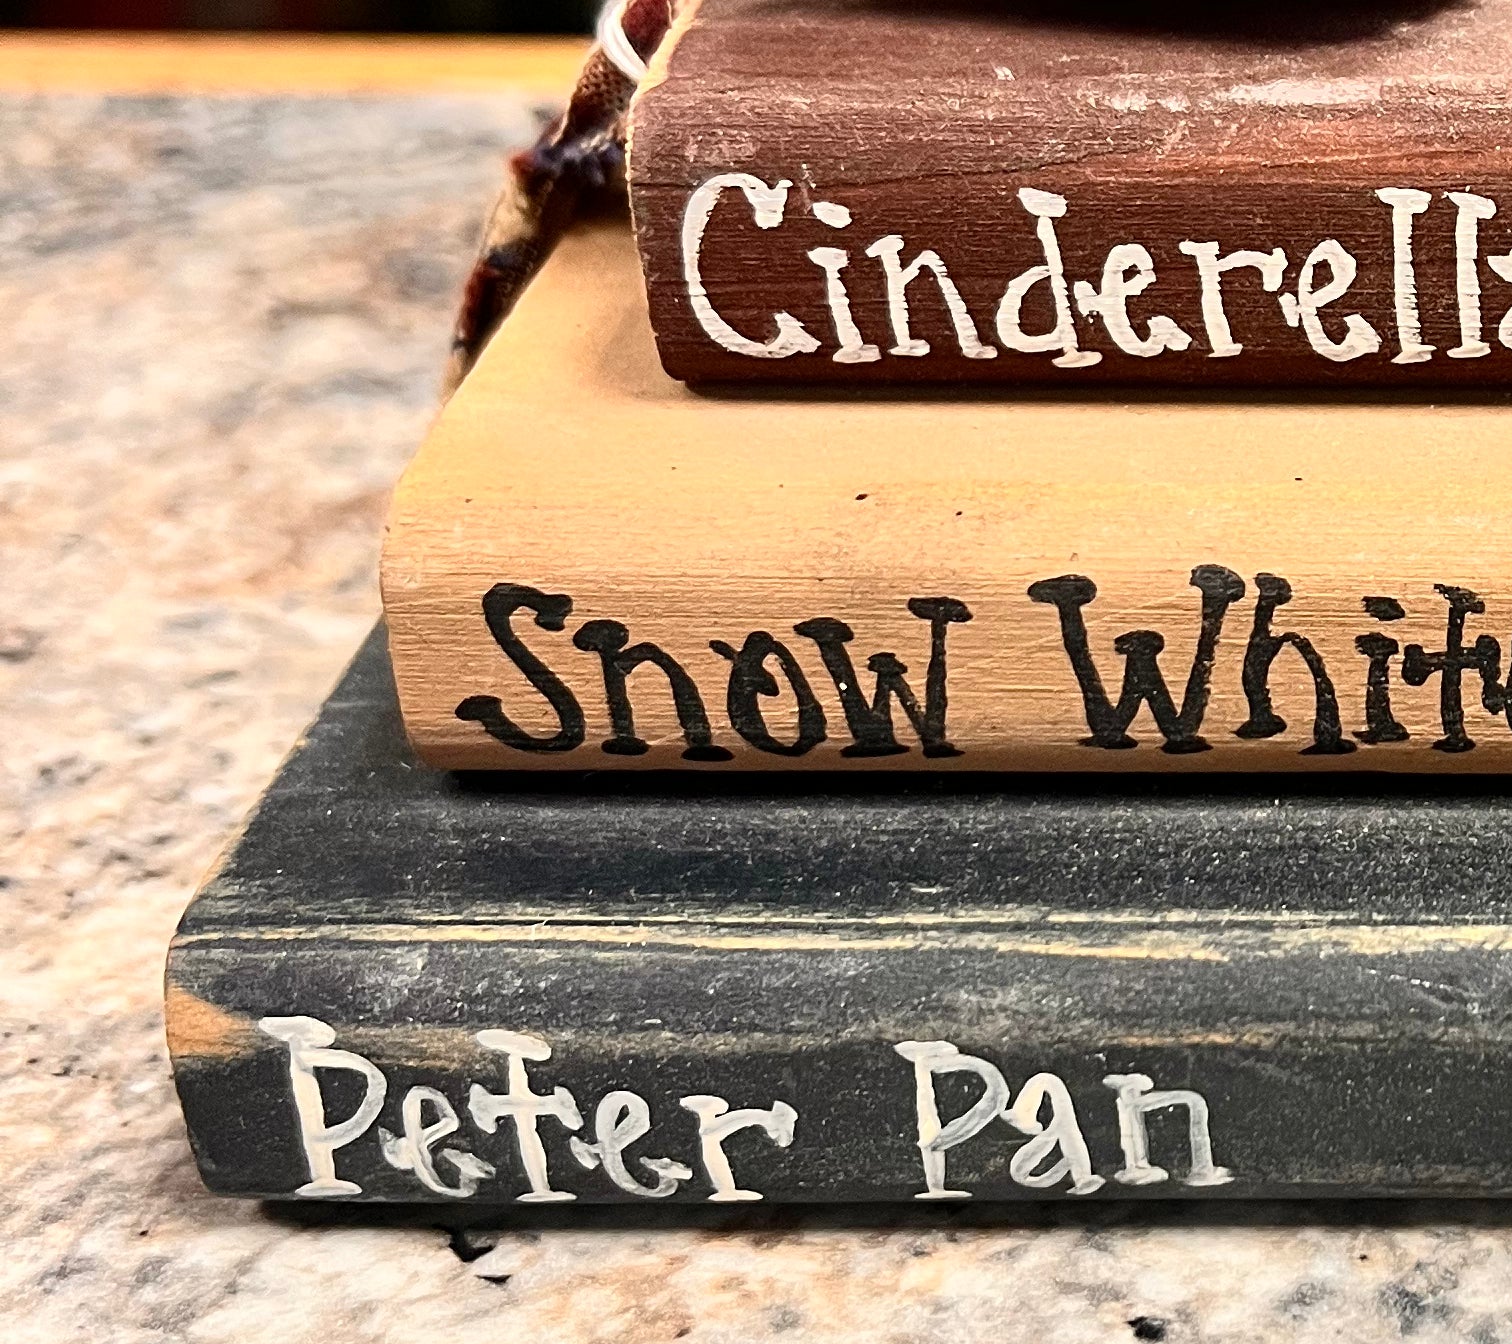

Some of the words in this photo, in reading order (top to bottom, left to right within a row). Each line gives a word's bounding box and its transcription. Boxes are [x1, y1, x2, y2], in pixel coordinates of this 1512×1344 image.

[454, 582, 972, 760] Snow
[258, 1016, 798, 1202] Peter
[893, 1040, 1236, 1200] Pan
